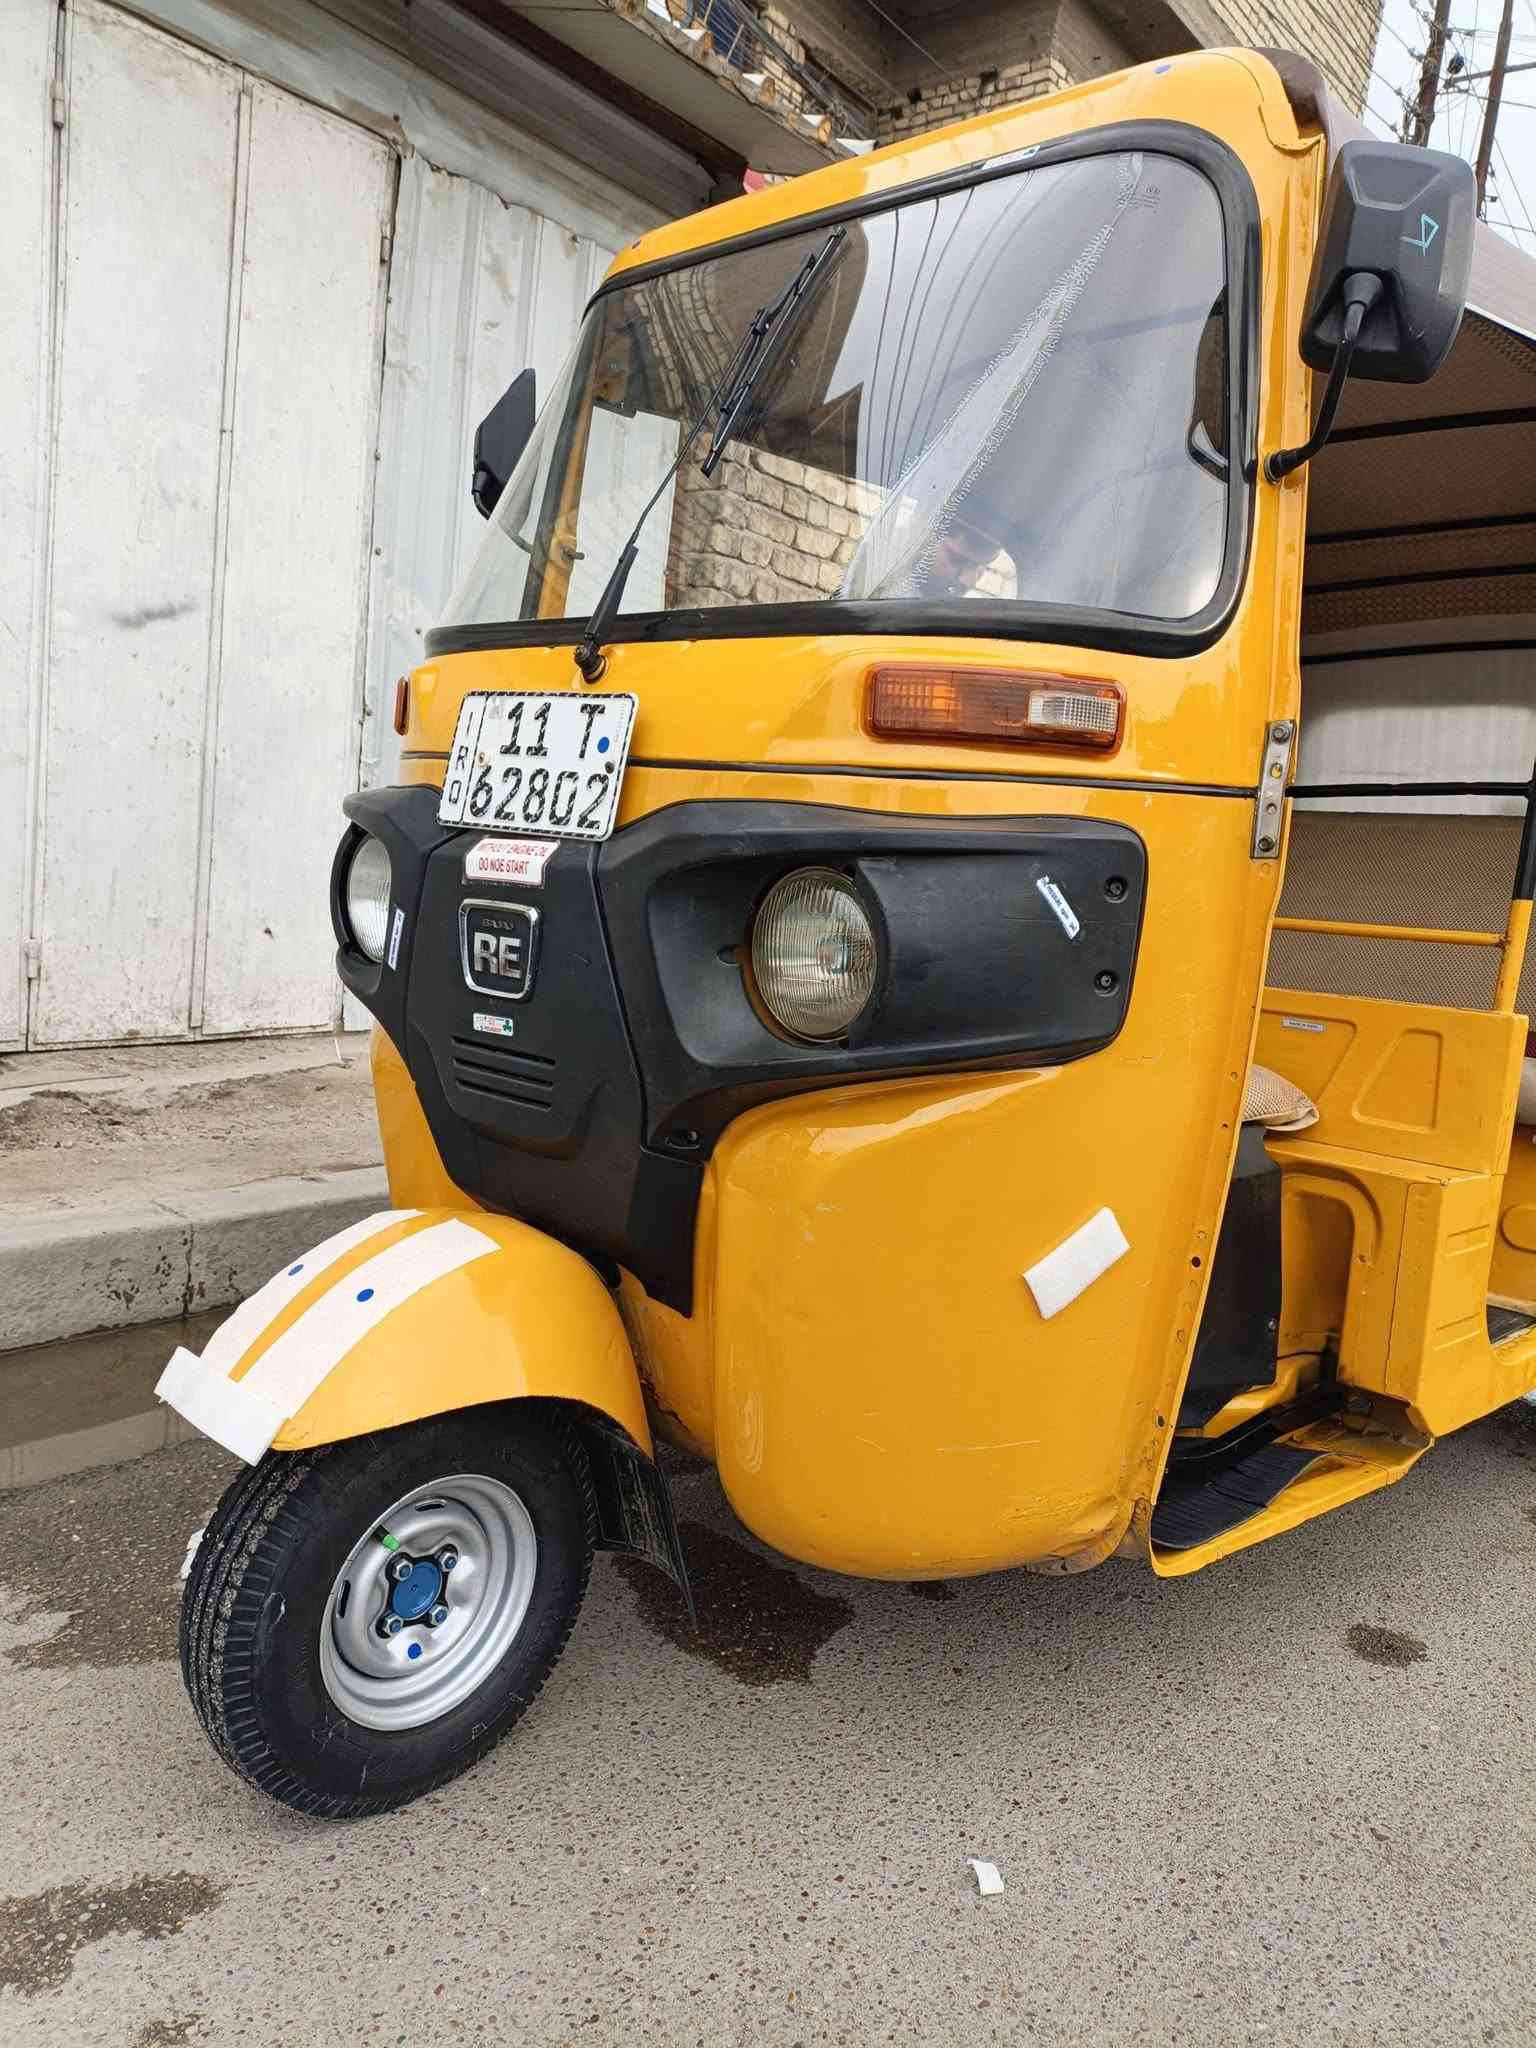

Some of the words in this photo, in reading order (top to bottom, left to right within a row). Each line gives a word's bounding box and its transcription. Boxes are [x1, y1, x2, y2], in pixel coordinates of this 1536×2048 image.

[500, 701, 551, 756] 11
[578, 703, 606, 759] T
[469, 765, 610, 829] 62802
[479, 857, 489, 871] DO
[505, 859, 529, 875] START
[474, 931, 521, 979] RE
